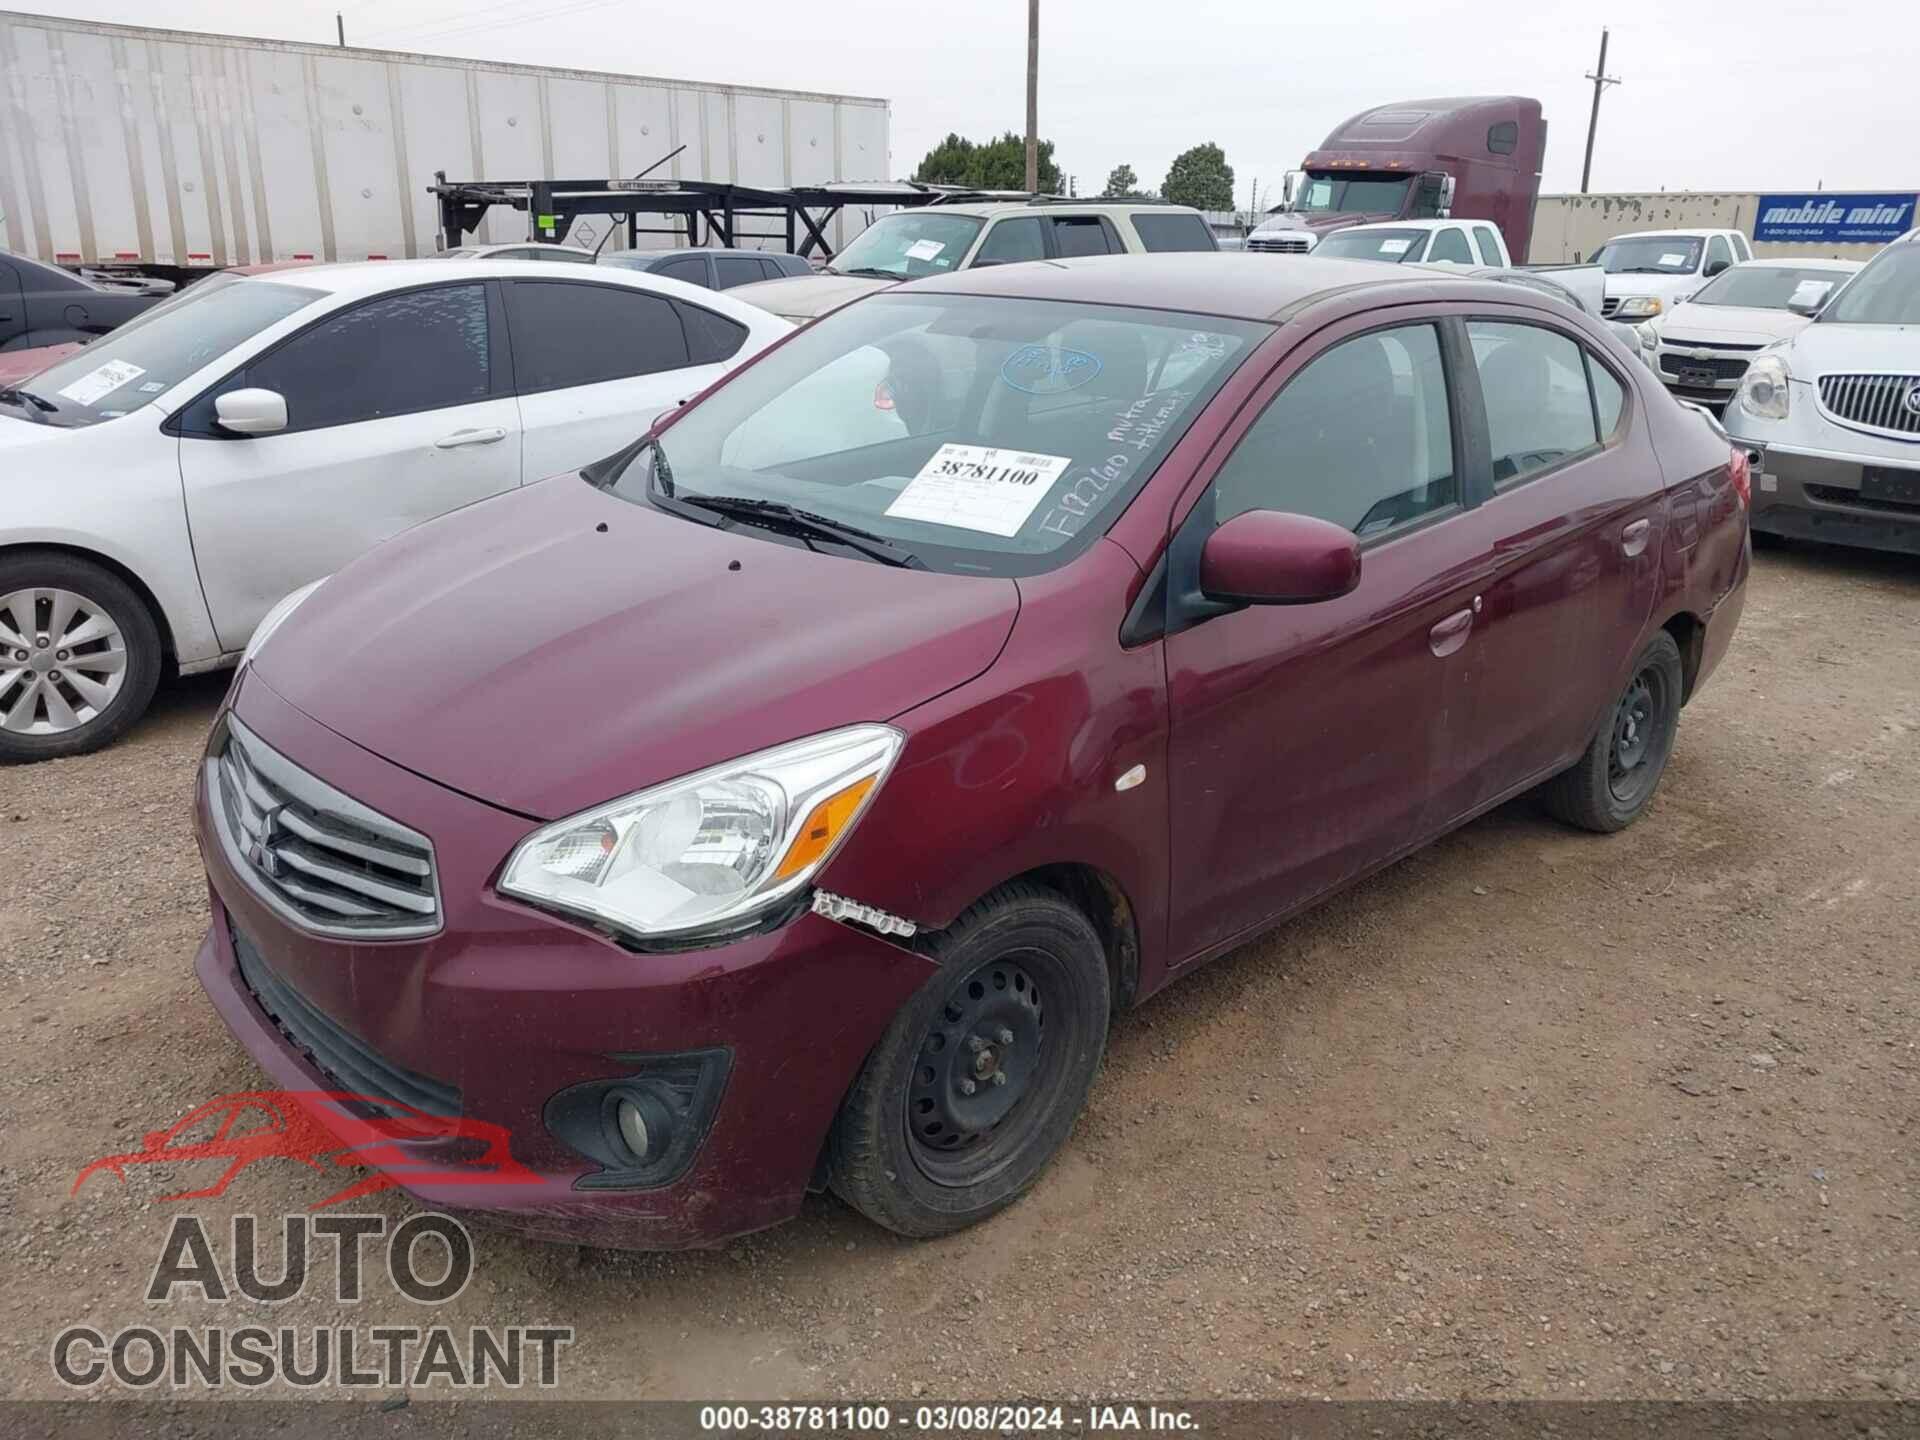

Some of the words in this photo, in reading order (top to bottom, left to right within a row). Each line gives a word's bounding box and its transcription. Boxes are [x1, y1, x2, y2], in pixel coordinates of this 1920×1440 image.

[1763, 200, 1845, 224] mobile
[1845, 203, 1912, 224] mini
[932, 460, 1039, 485] 38781100
